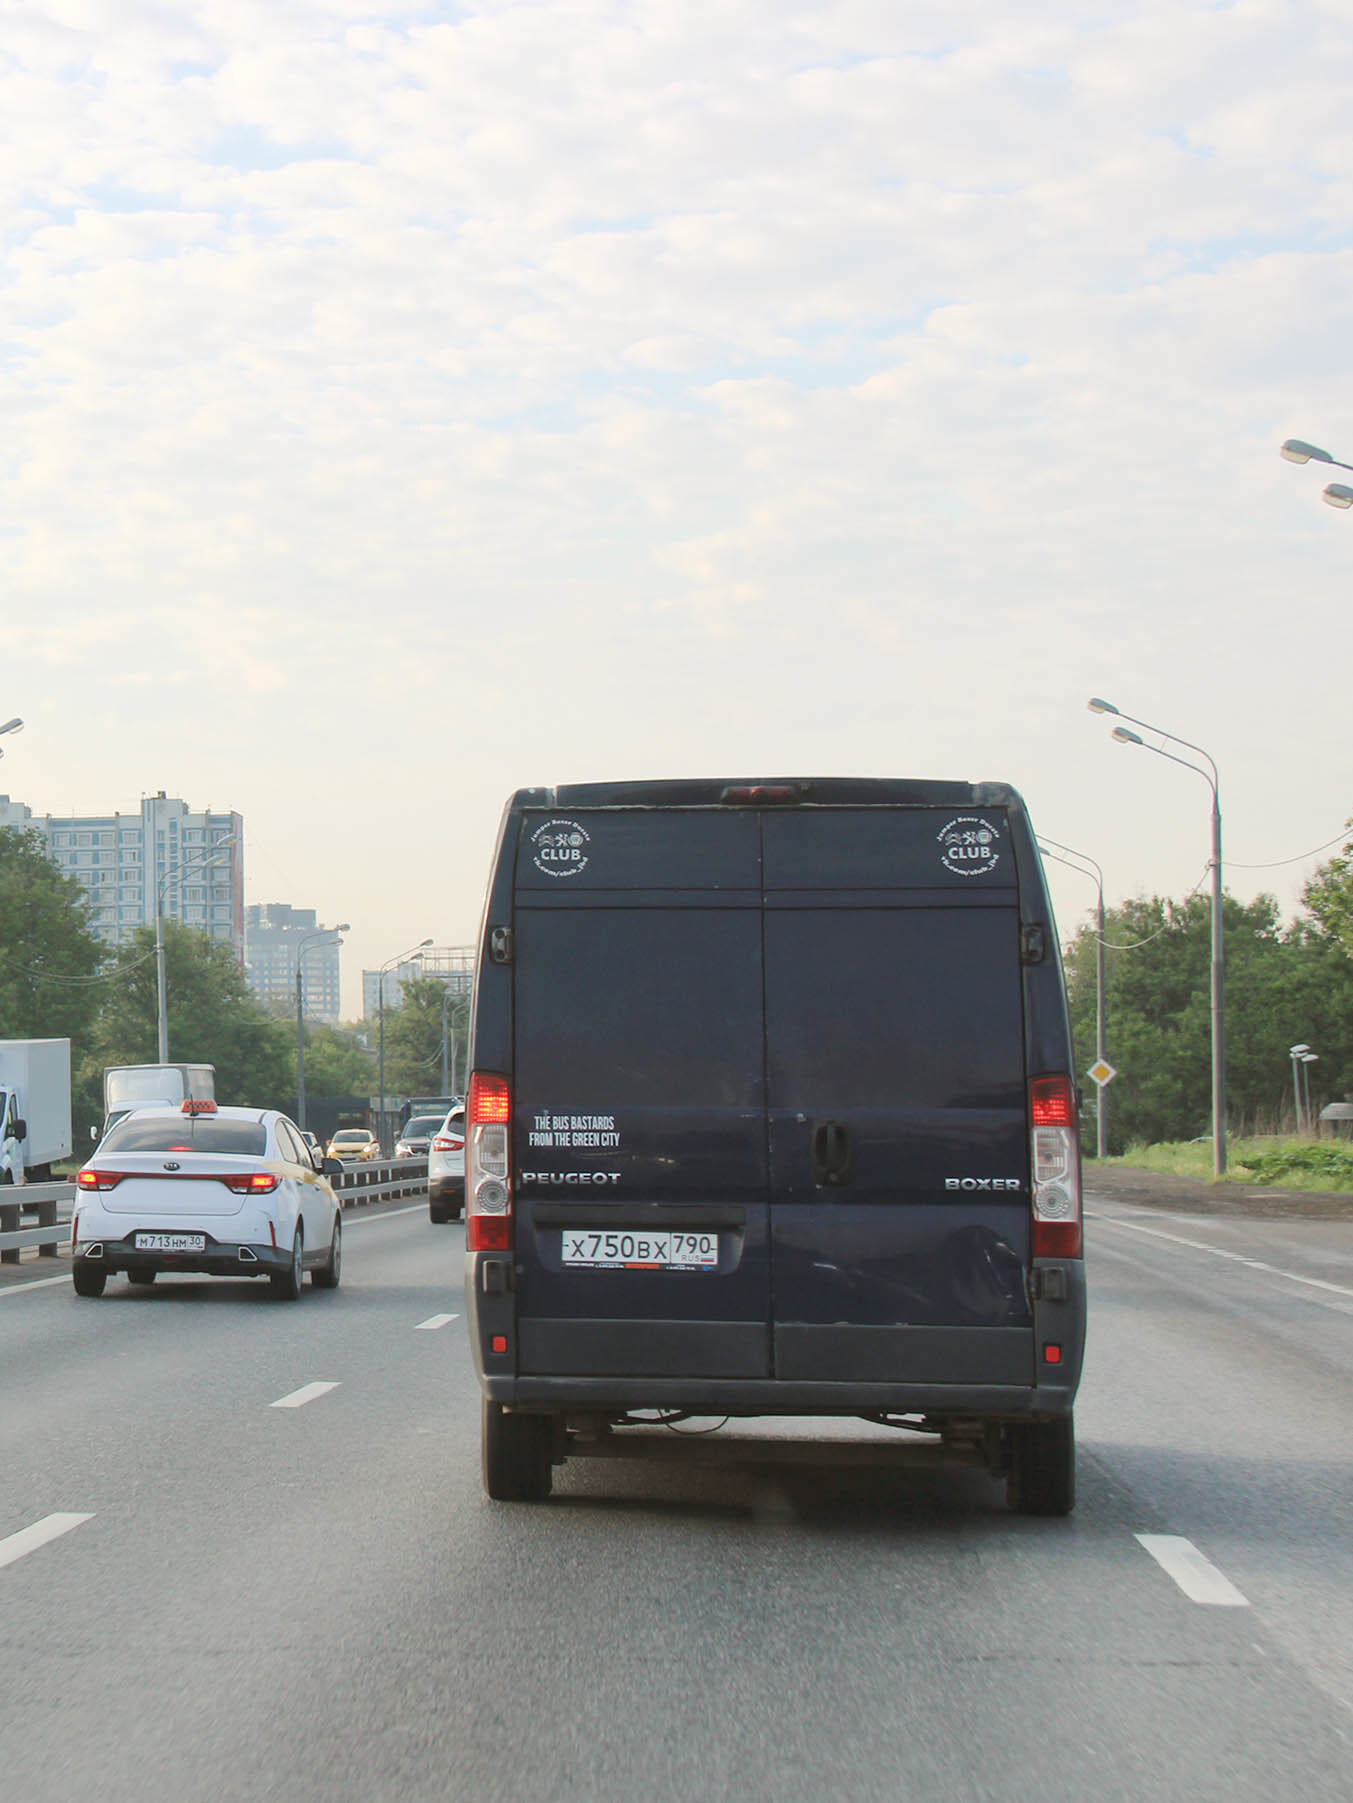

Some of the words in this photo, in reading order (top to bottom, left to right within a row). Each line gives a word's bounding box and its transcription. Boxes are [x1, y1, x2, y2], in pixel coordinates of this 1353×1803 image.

[540, 848, 581, 860] CLUB
[948, 847, 991, 859] CLUB
[534, 1115, 551, 1129] THE
[552, 1115, 569, 1129] BUS
[570, 1115, 615, 1129] BASTARDS
[529, 1132, 553, 1146] FROM
[554, 1132, 571, 1146] THE
[572, 1132, 600, 1146] GREEN
[601, 1132, 620, 1146] CITY
[521, 1172, 622, 1184] PEUGEOT
[944, 1178, 1021, 1191] BOXER
[673, 1235, 711, 1254] 790
